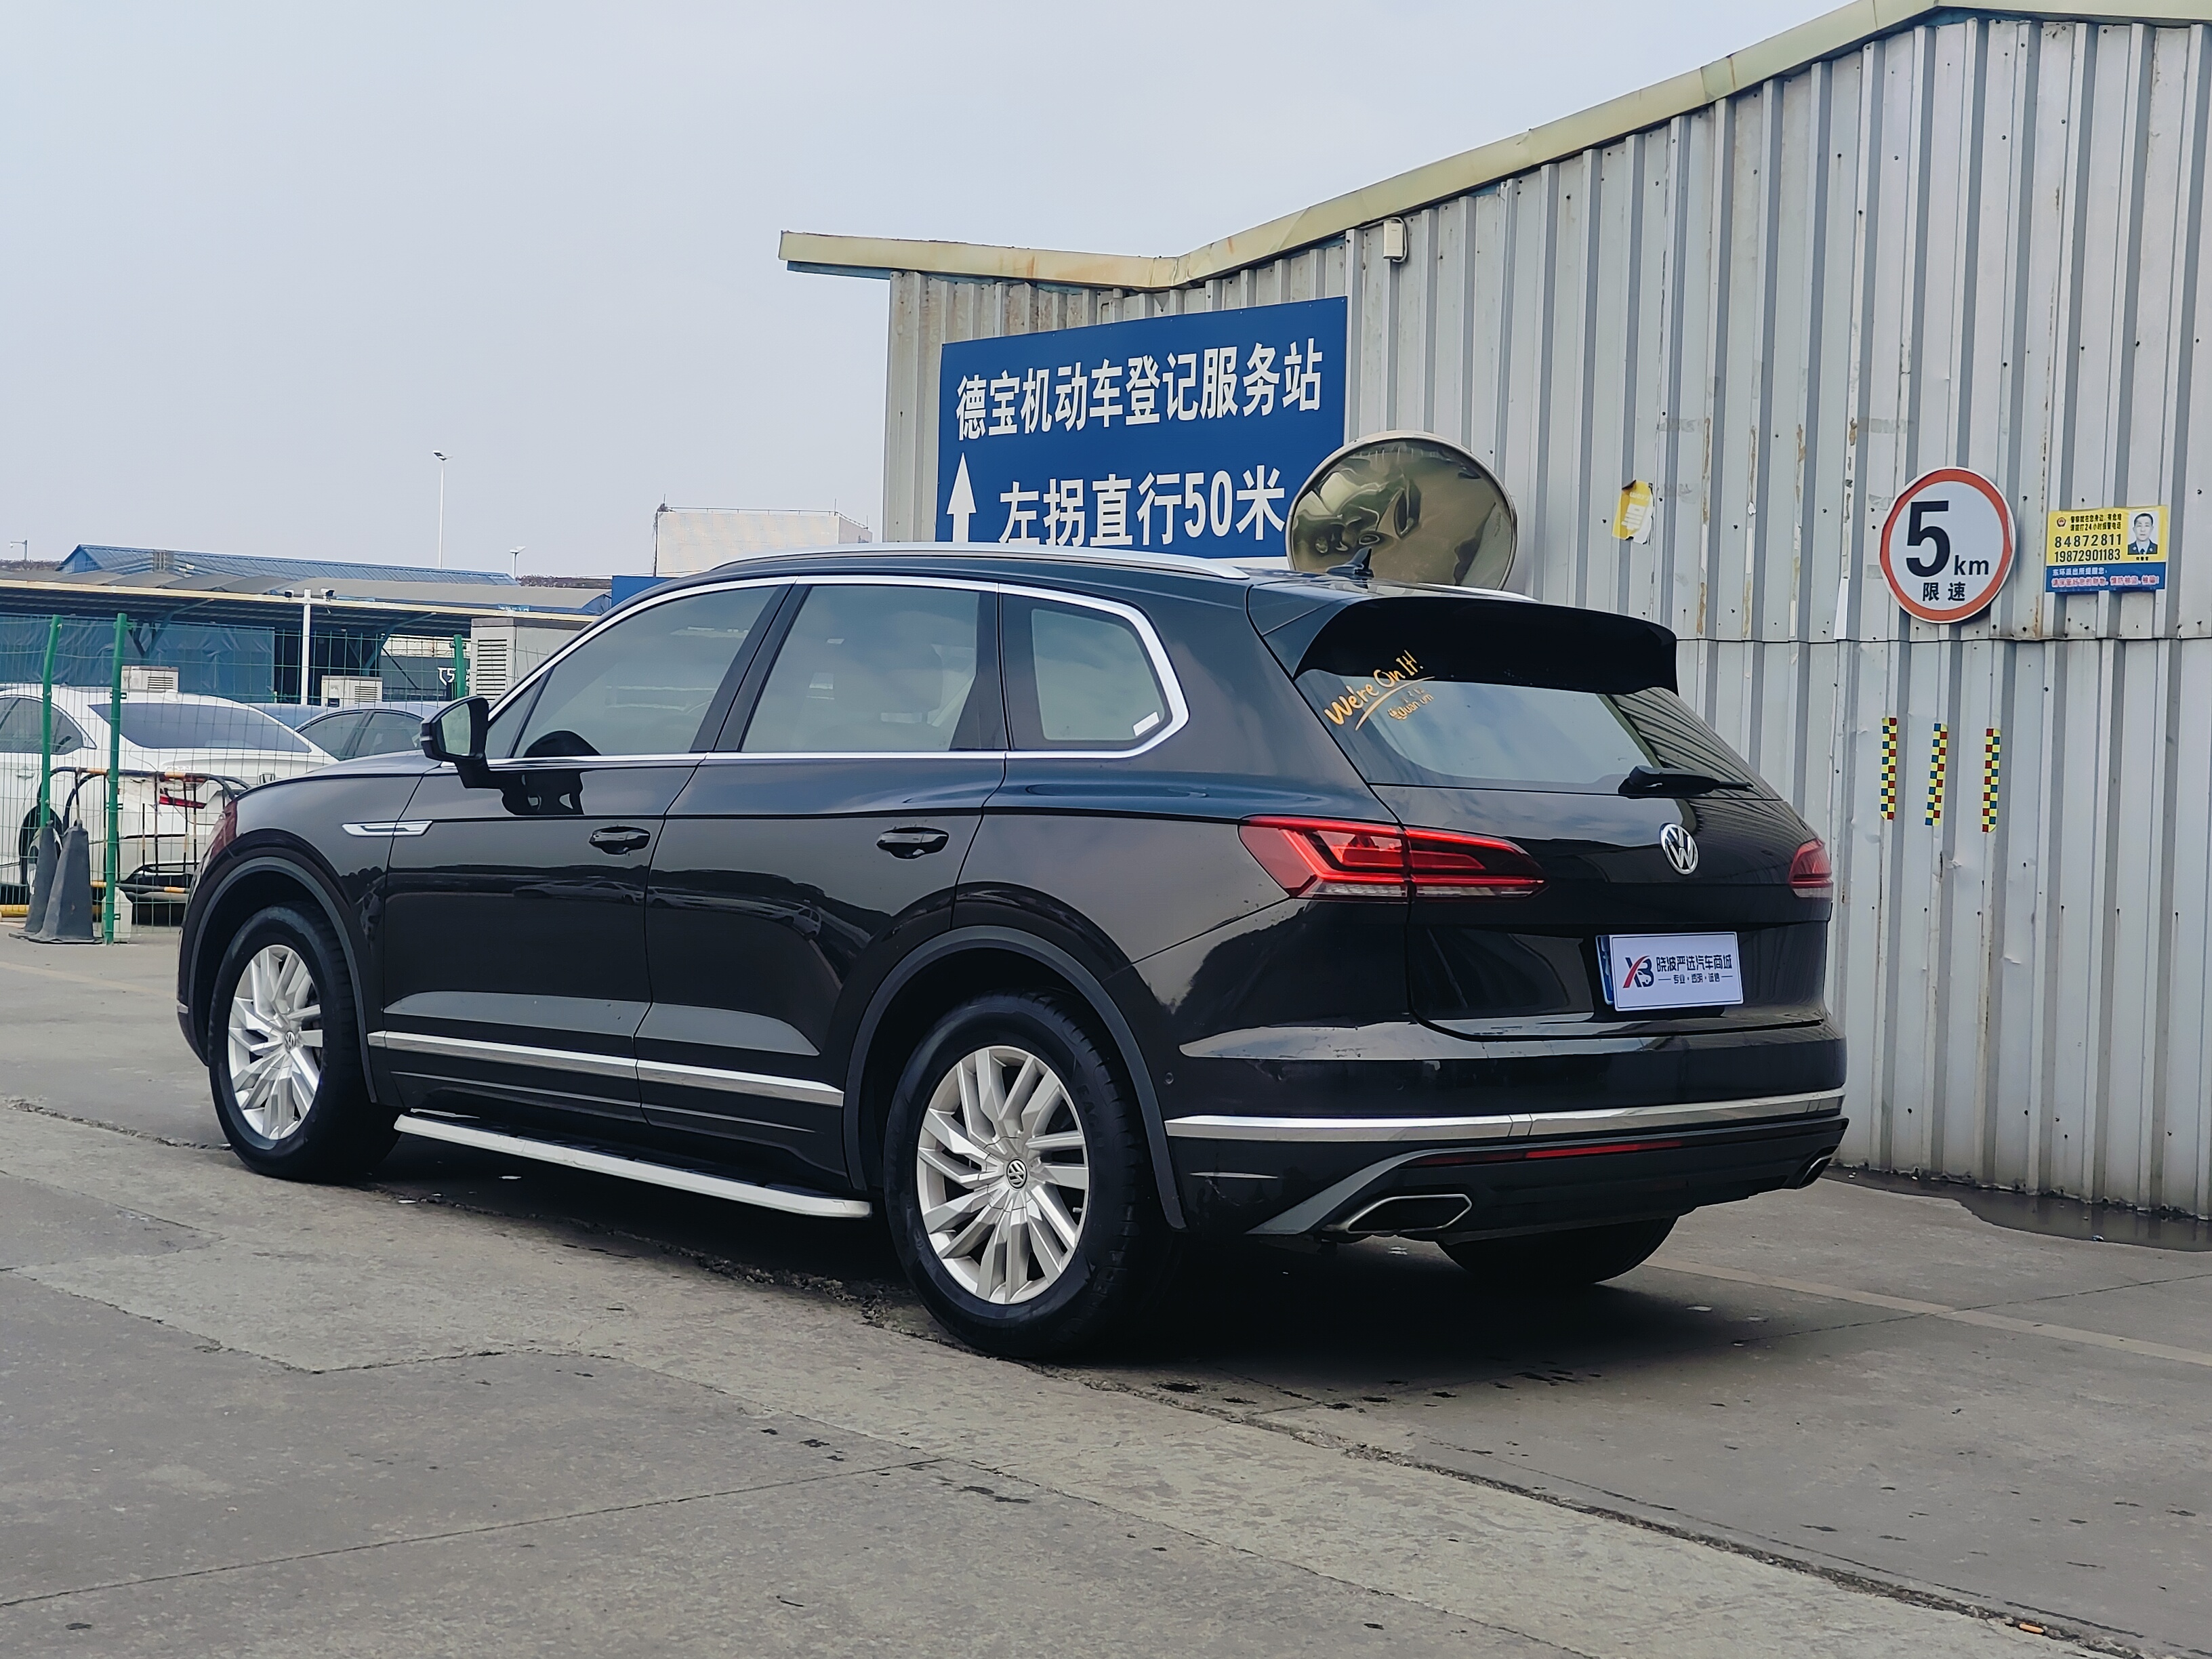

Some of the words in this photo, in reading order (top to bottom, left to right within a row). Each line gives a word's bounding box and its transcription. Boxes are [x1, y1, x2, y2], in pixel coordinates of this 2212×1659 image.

[956, 337, 1323, 441] 德宝机动车登记服务站
[998, 464, 1286, 548] 左拐直行50米
[1906, 500, 1950, 577] 5
[1954, 554, 1989, 576] km
[2054, 548, 2121, 562] 19872901183
[2055, 533, 2121, 548] 84872811
[1922, 581, 1966, 602] 限速
[1324, 685, 1380, 725] We're
[1373, 669, 1406, 689] On
[1395, 649, 1424, 676] It!
[1656, 954, 1733, 972] 晓波严选汽车商城
